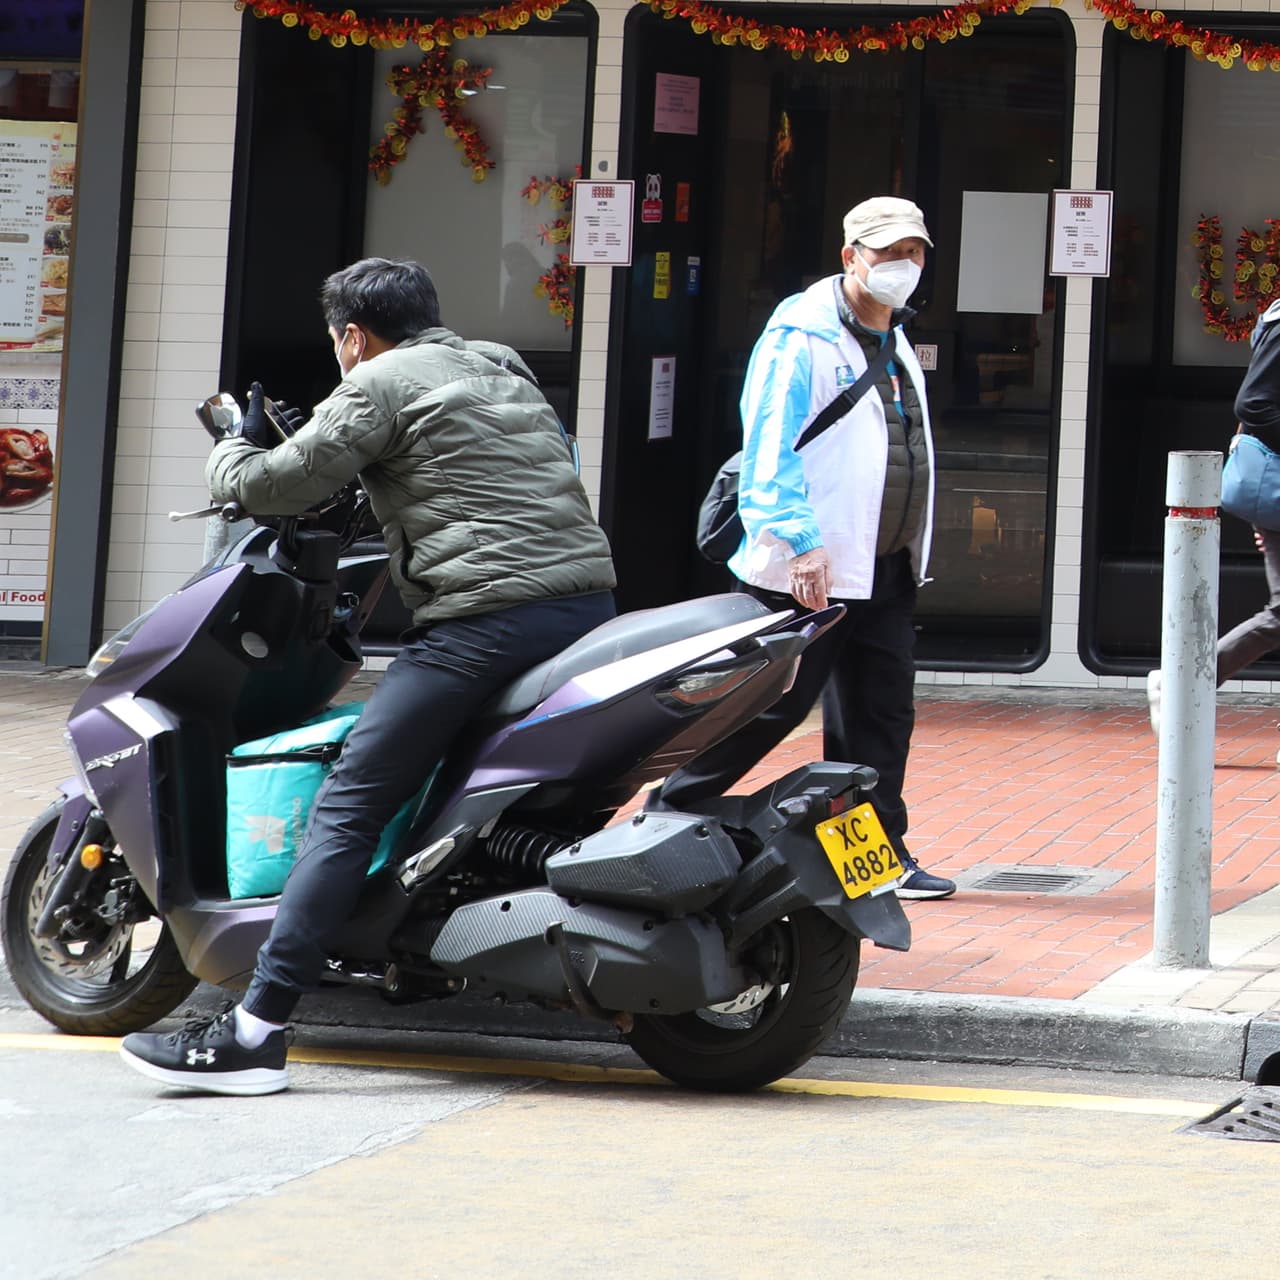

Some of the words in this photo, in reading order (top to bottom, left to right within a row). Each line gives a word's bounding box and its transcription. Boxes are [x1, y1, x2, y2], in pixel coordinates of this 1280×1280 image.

[11, 591, 46, 602] Food
[834, 817, 868, 850] XC
[843, 844, 899, 886] 4882
